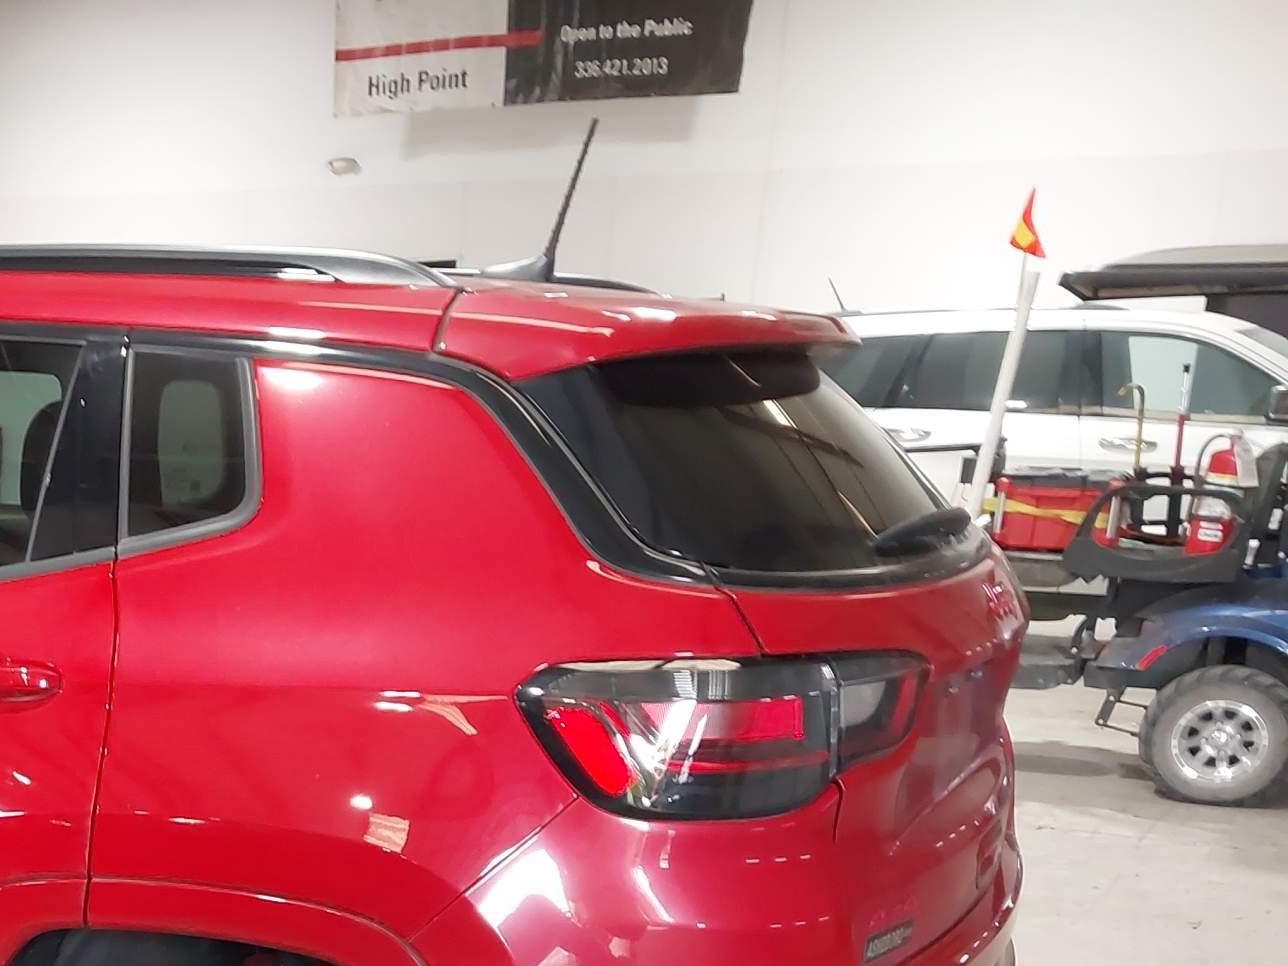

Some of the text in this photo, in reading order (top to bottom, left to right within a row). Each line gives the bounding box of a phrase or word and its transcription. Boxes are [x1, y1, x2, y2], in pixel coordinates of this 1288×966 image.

[560, 17, 694, 44] Open to the Public
[367, 68, 469, 100] High Point
